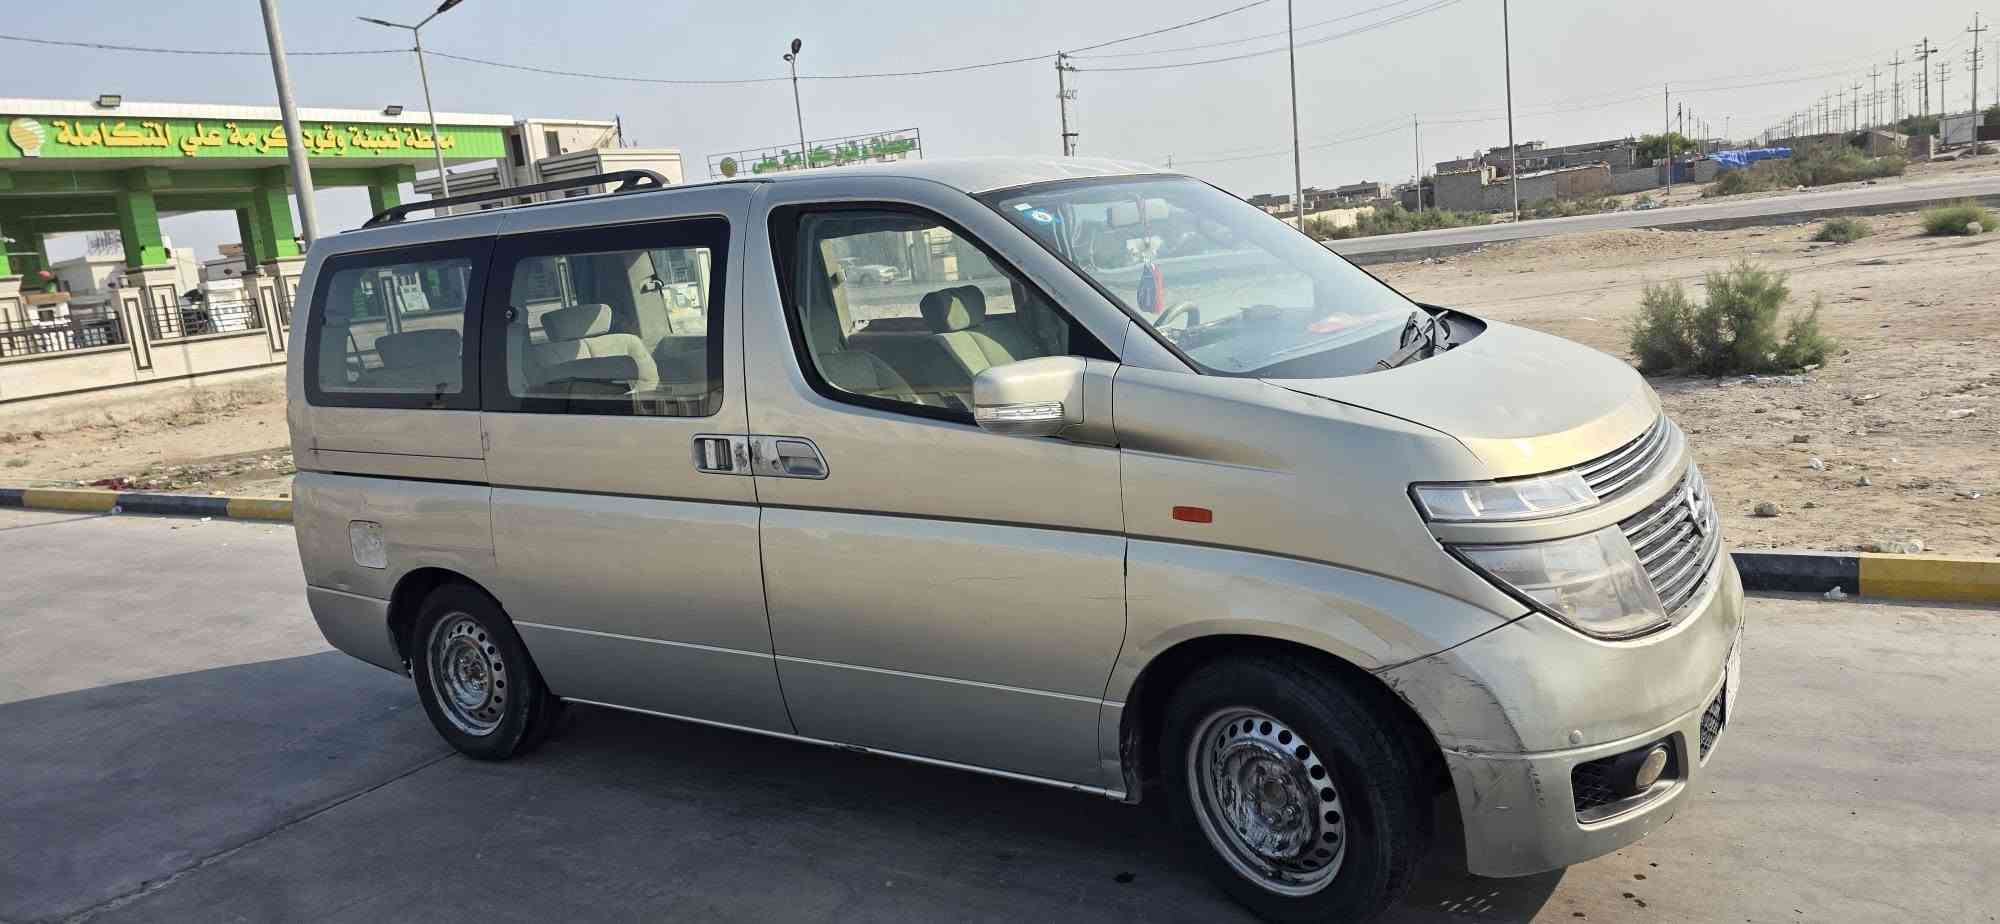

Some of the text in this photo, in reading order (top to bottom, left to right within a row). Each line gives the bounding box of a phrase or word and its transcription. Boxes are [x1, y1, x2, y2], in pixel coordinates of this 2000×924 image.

[53, 119, 171, 147] المتكاملة
[179, 122, 224, 156] علي
[347, 127, 400, 156] تعبئة
